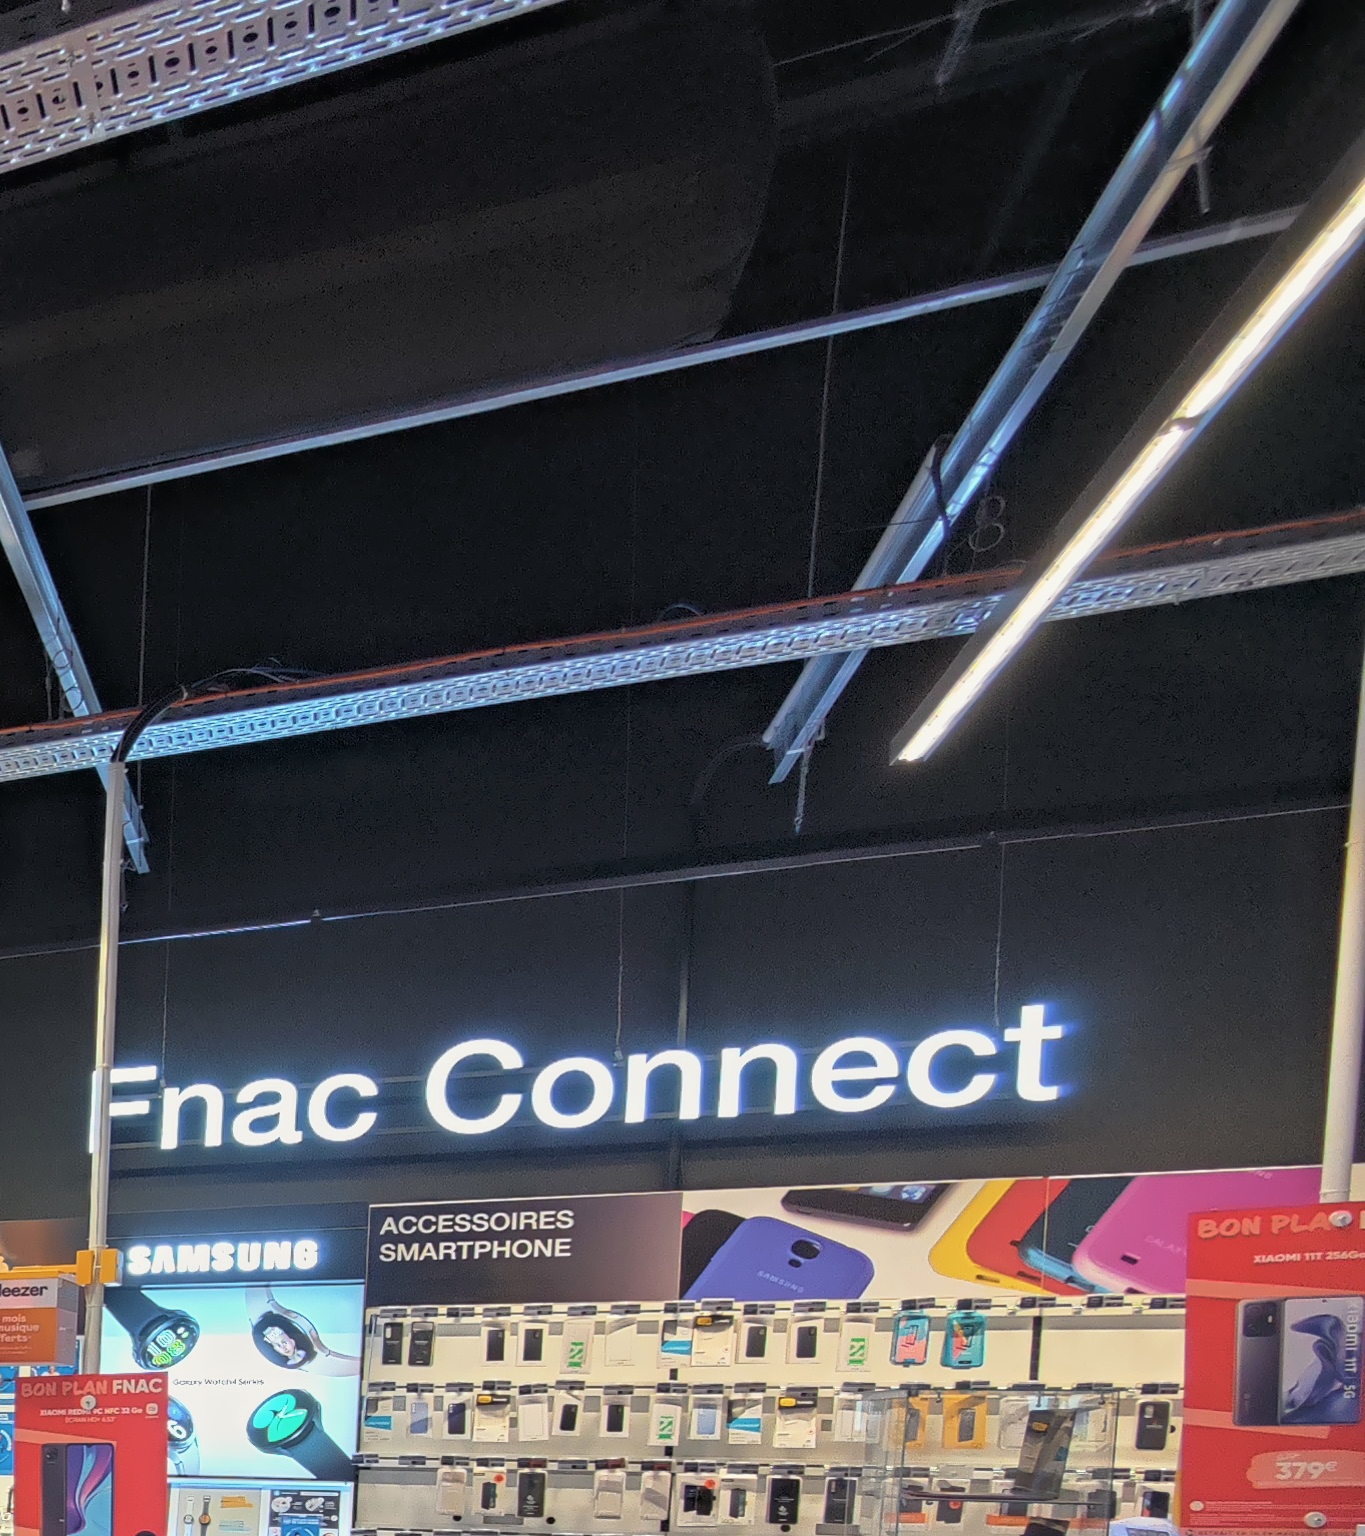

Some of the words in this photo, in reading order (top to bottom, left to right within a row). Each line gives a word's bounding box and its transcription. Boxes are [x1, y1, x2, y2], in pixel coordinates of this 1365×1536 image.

[89, 1065, 379, 1153] Fnac
[426, 1004, 1063, 1135] Connect
[380, 1209, 575, 1236] ACCESSOIRES
[1197, 1216, 1262, 1240] BON
[1271, 1211, 1337, 1234] PLA
[128, 1239, 319, 1275] SAMSUNG
[379, 1237, 572, 1263] SMARTPHONE
[1253, 1253, 1302, 1264] XIAOMI
[1305, 1251, 1323, 1261] 11T
[2, 1314, 26, 1323] mois
[21, 1380, 58, 1397] BON
[62, 1379, 108, 1395] PLAN
[113, 1378, 163, 1394] FNAC
[39, 1408, 67, 1417] XIAOMI
[104, 1408, 120, 1416] NFC
[1275, 1460, 1338, 1480] 379€
